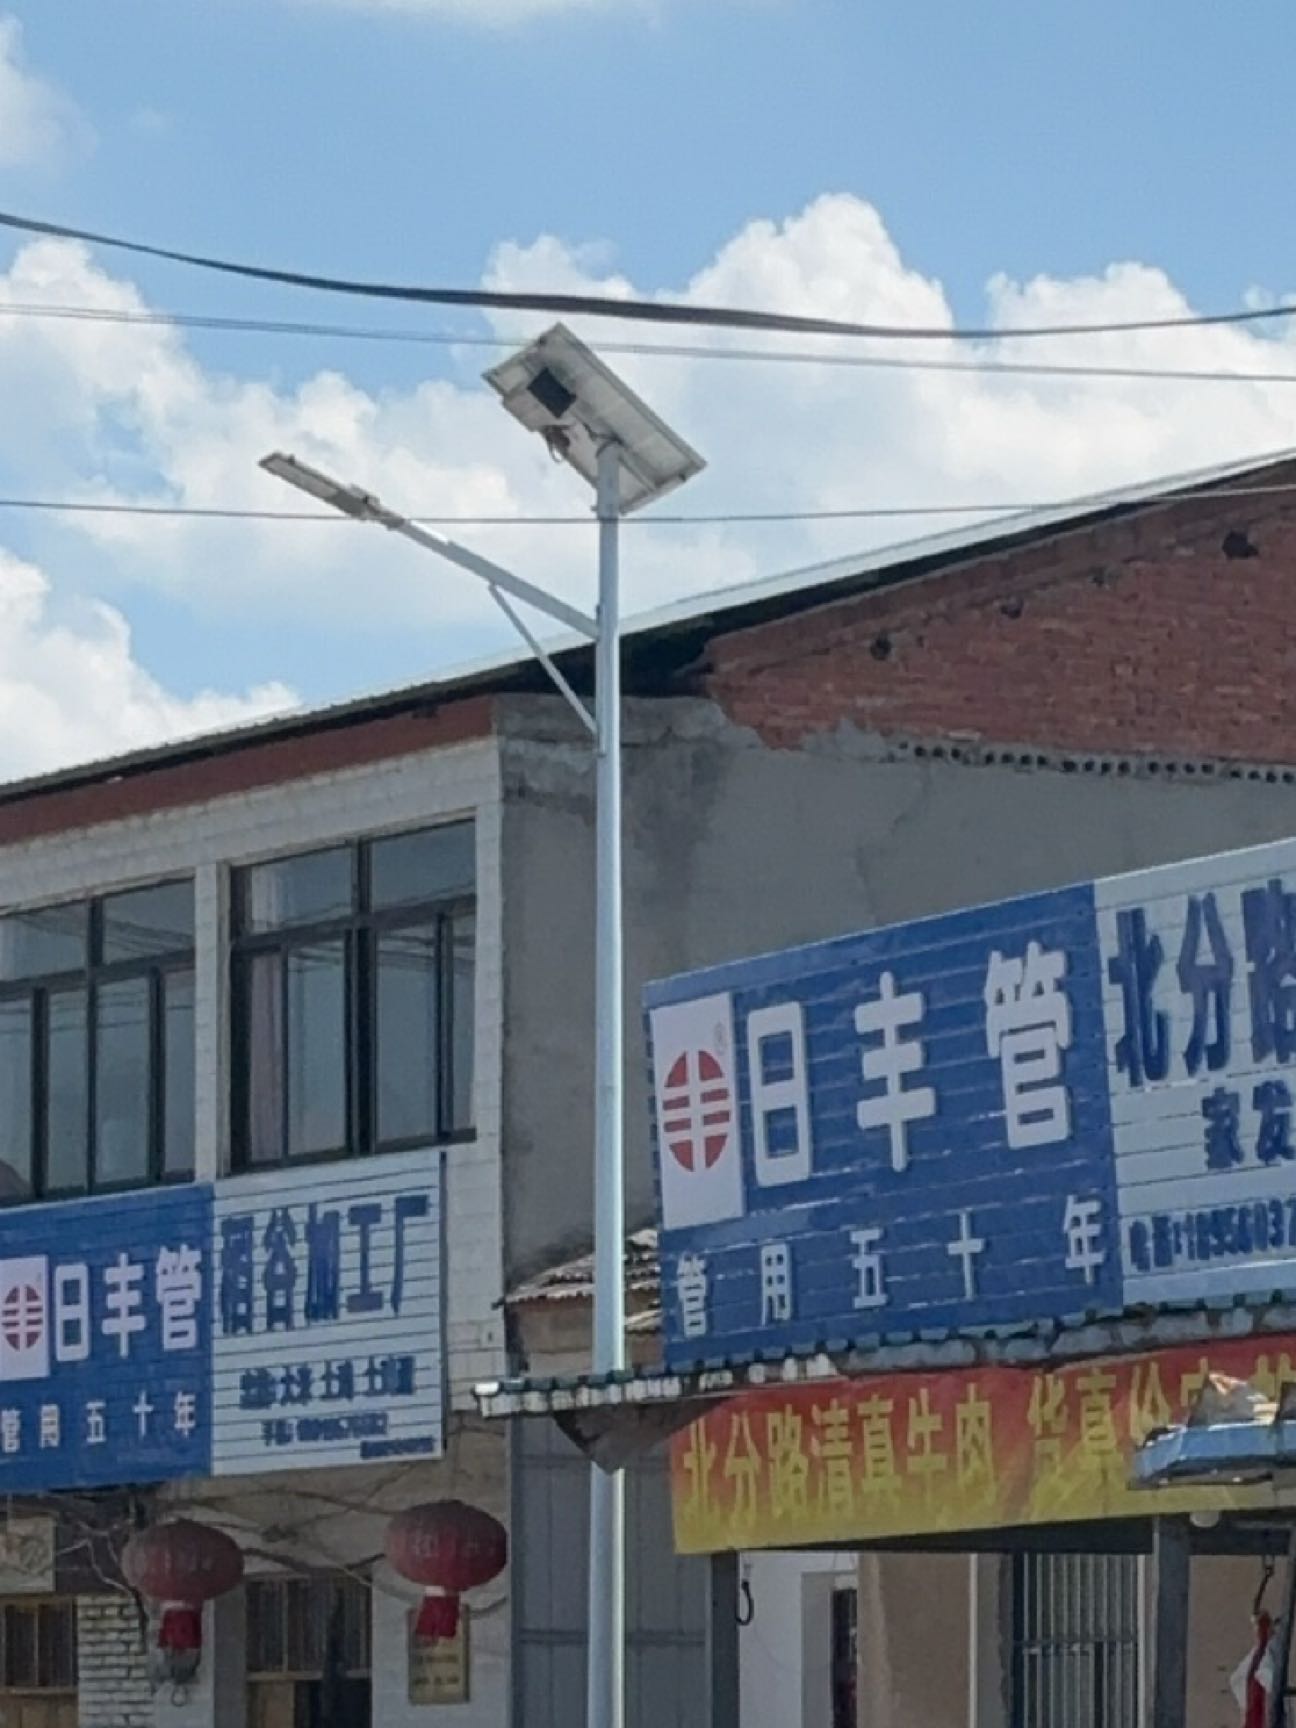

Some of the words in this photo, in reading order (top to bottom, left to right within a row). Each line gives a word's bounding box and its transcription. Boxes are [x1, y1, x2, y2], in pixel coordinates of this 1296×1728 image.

[744, 941, 1072, 1188] 日丰管
[54, 1243, 202, 1361] 日丰管
[677, 1194, 1105, 1337] 管用五十年
[1, 1390, 197, 1454] 管用五十年
[683, 1384, 995, 1524] 北分路清真牛肉
